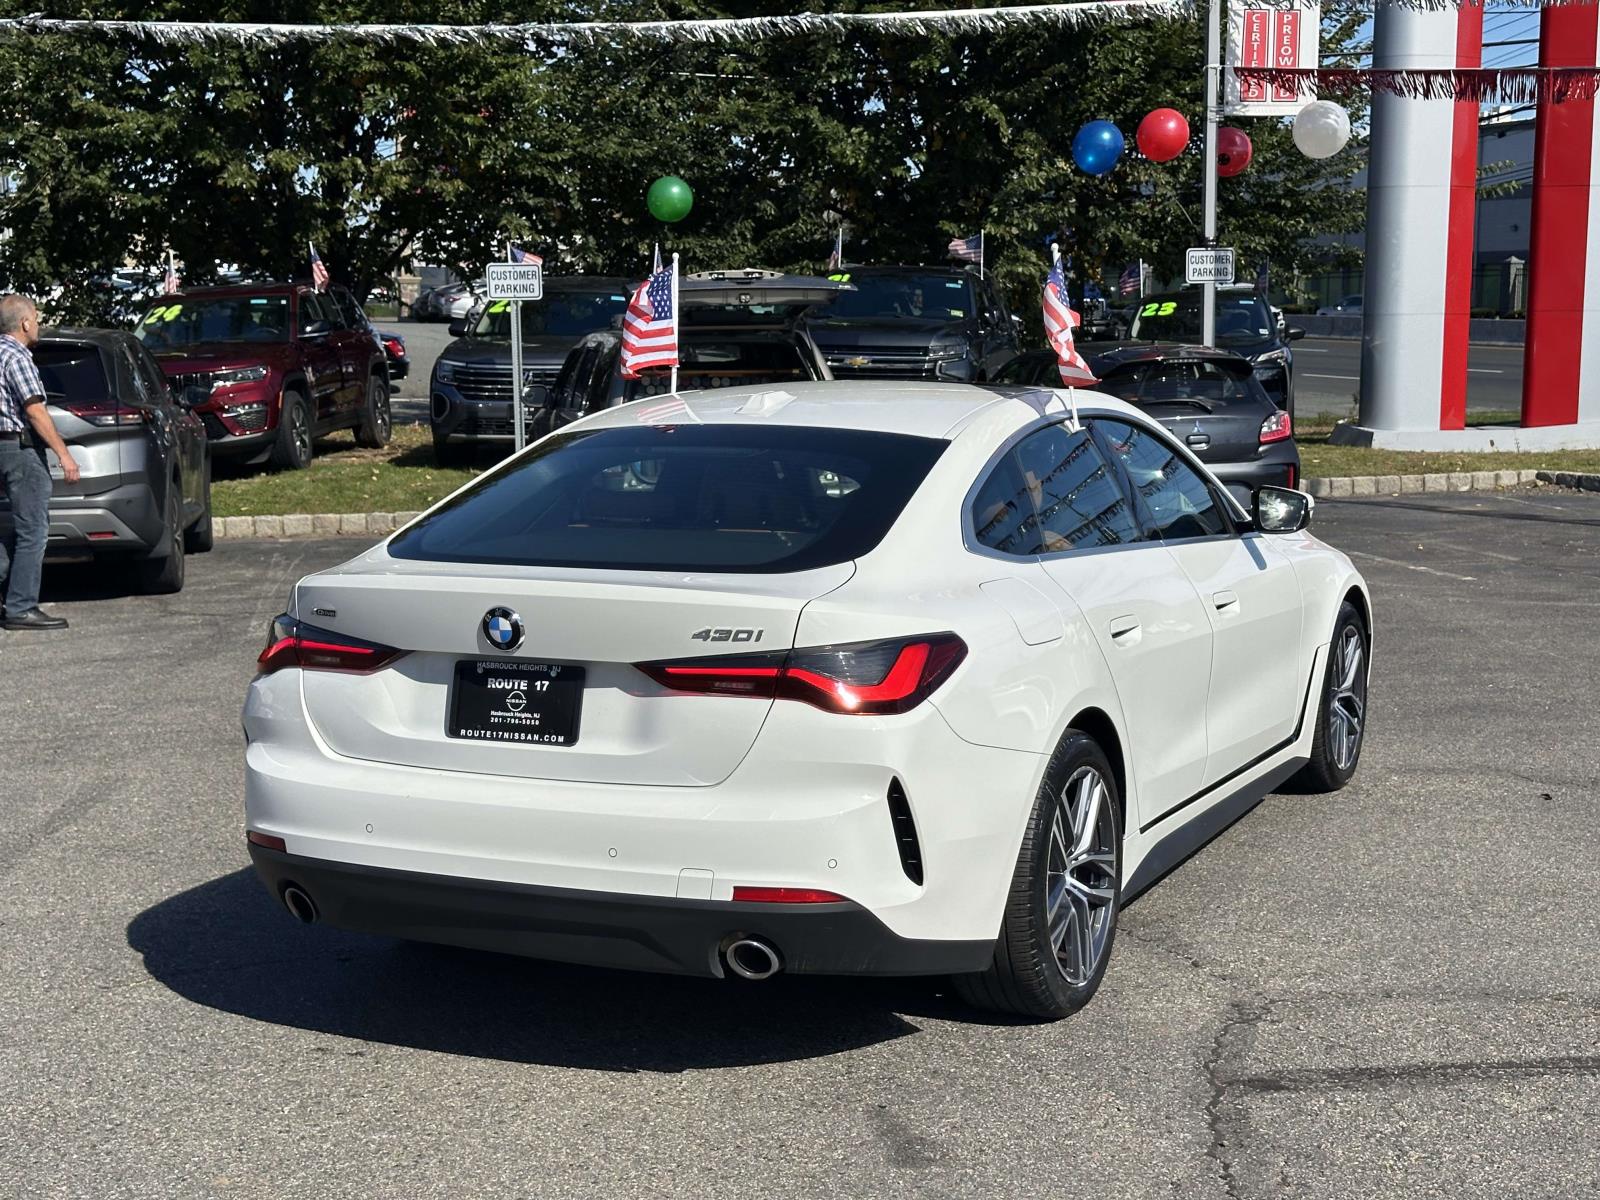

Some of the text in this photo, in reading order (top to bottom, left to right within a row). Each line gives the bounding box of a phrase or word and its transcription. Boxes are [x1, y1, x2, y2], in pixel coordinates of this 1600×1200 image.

[1248, 13, 1261, 97] CERTIFED
[1279, 14, 1294, 98] PREOWD
[1190, 255, 1231, 265] CUSTOMER
[491, 270, 537, 280] CUSTOMER
[1192, 267, 1228, 277] PARKING
[494, 283, 535, 294] PARKING
[1141, 301, 1177, 317] 23
[477, 661, 518, 671] HASBROUCK
[487, 678, 549, 691] ROUTE 17
[460, 728, 564, 743] ROUTE17NISSAN.COM
